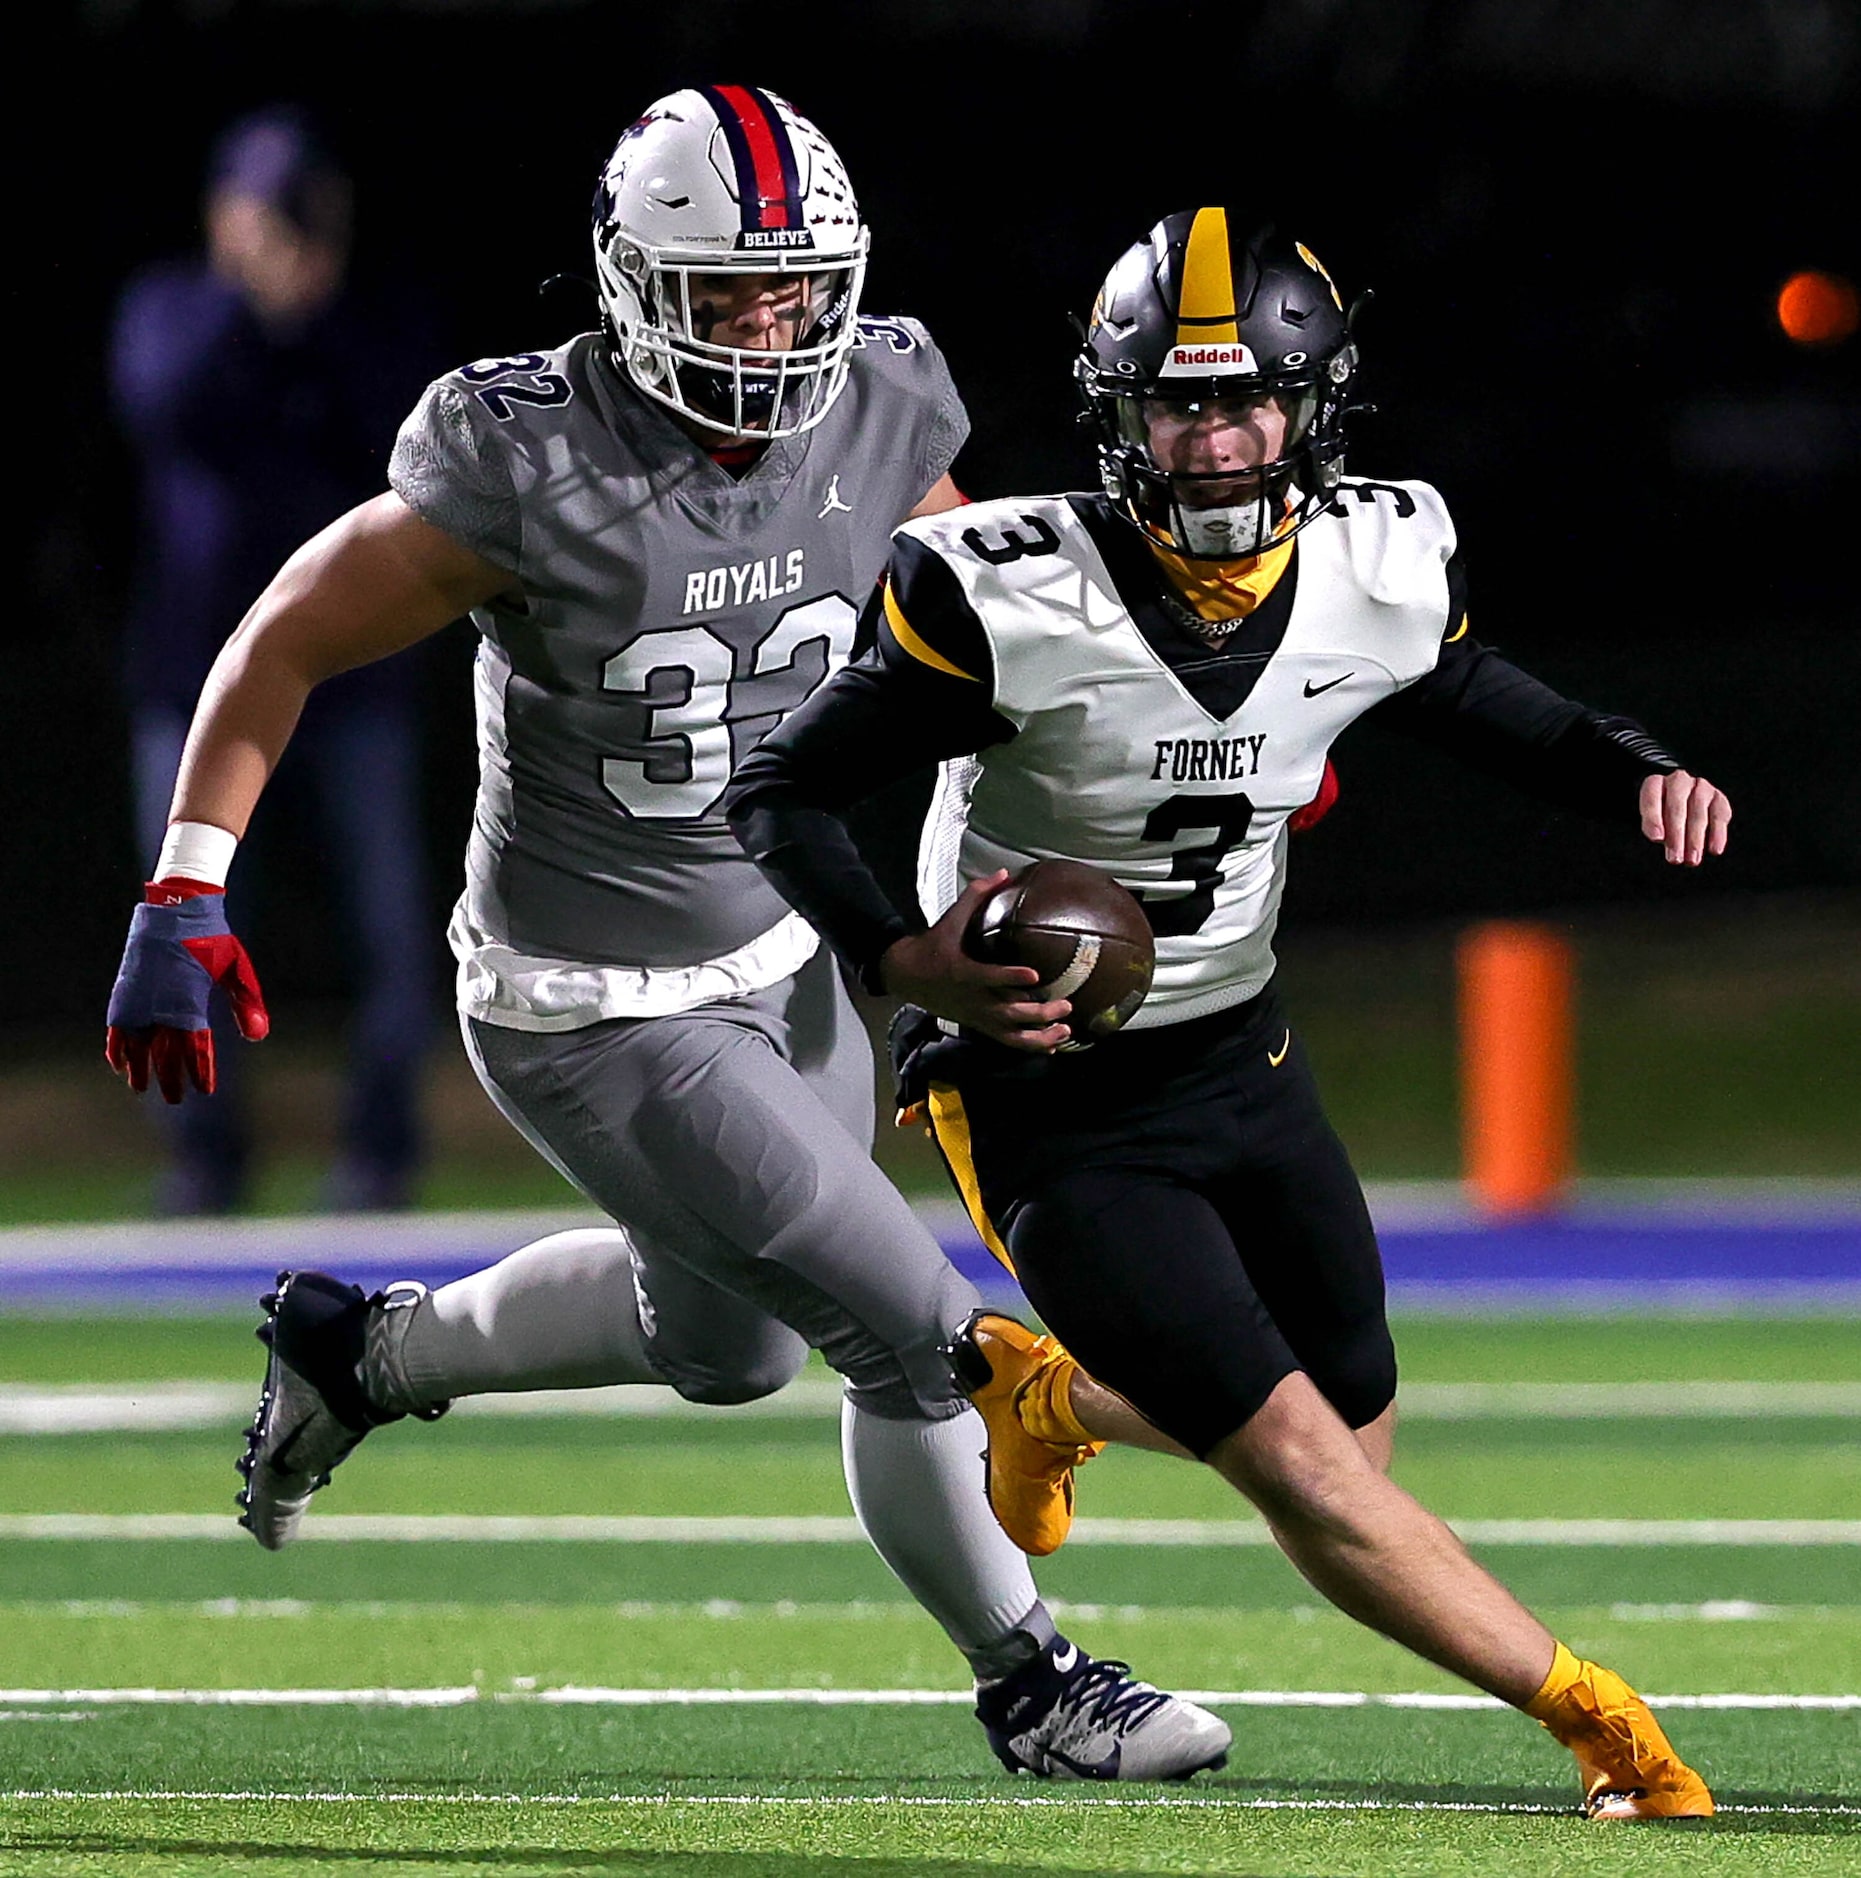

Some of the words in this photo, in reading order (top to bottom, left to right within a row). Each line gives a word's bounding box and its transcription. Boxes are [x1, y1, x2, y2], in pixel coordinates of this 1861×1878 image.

[744, 229, 809, 247] BELIEVE
[1174, 348, 1243, 365] Riddell
[459, 354, 575, 421] 32
[961, 515, 1061, 566] 3
[683, 549, 803, 614] ROYALS
[1151, 733, 1267, 781] FORNEY
[1129, 792, 1256, 938] 3
